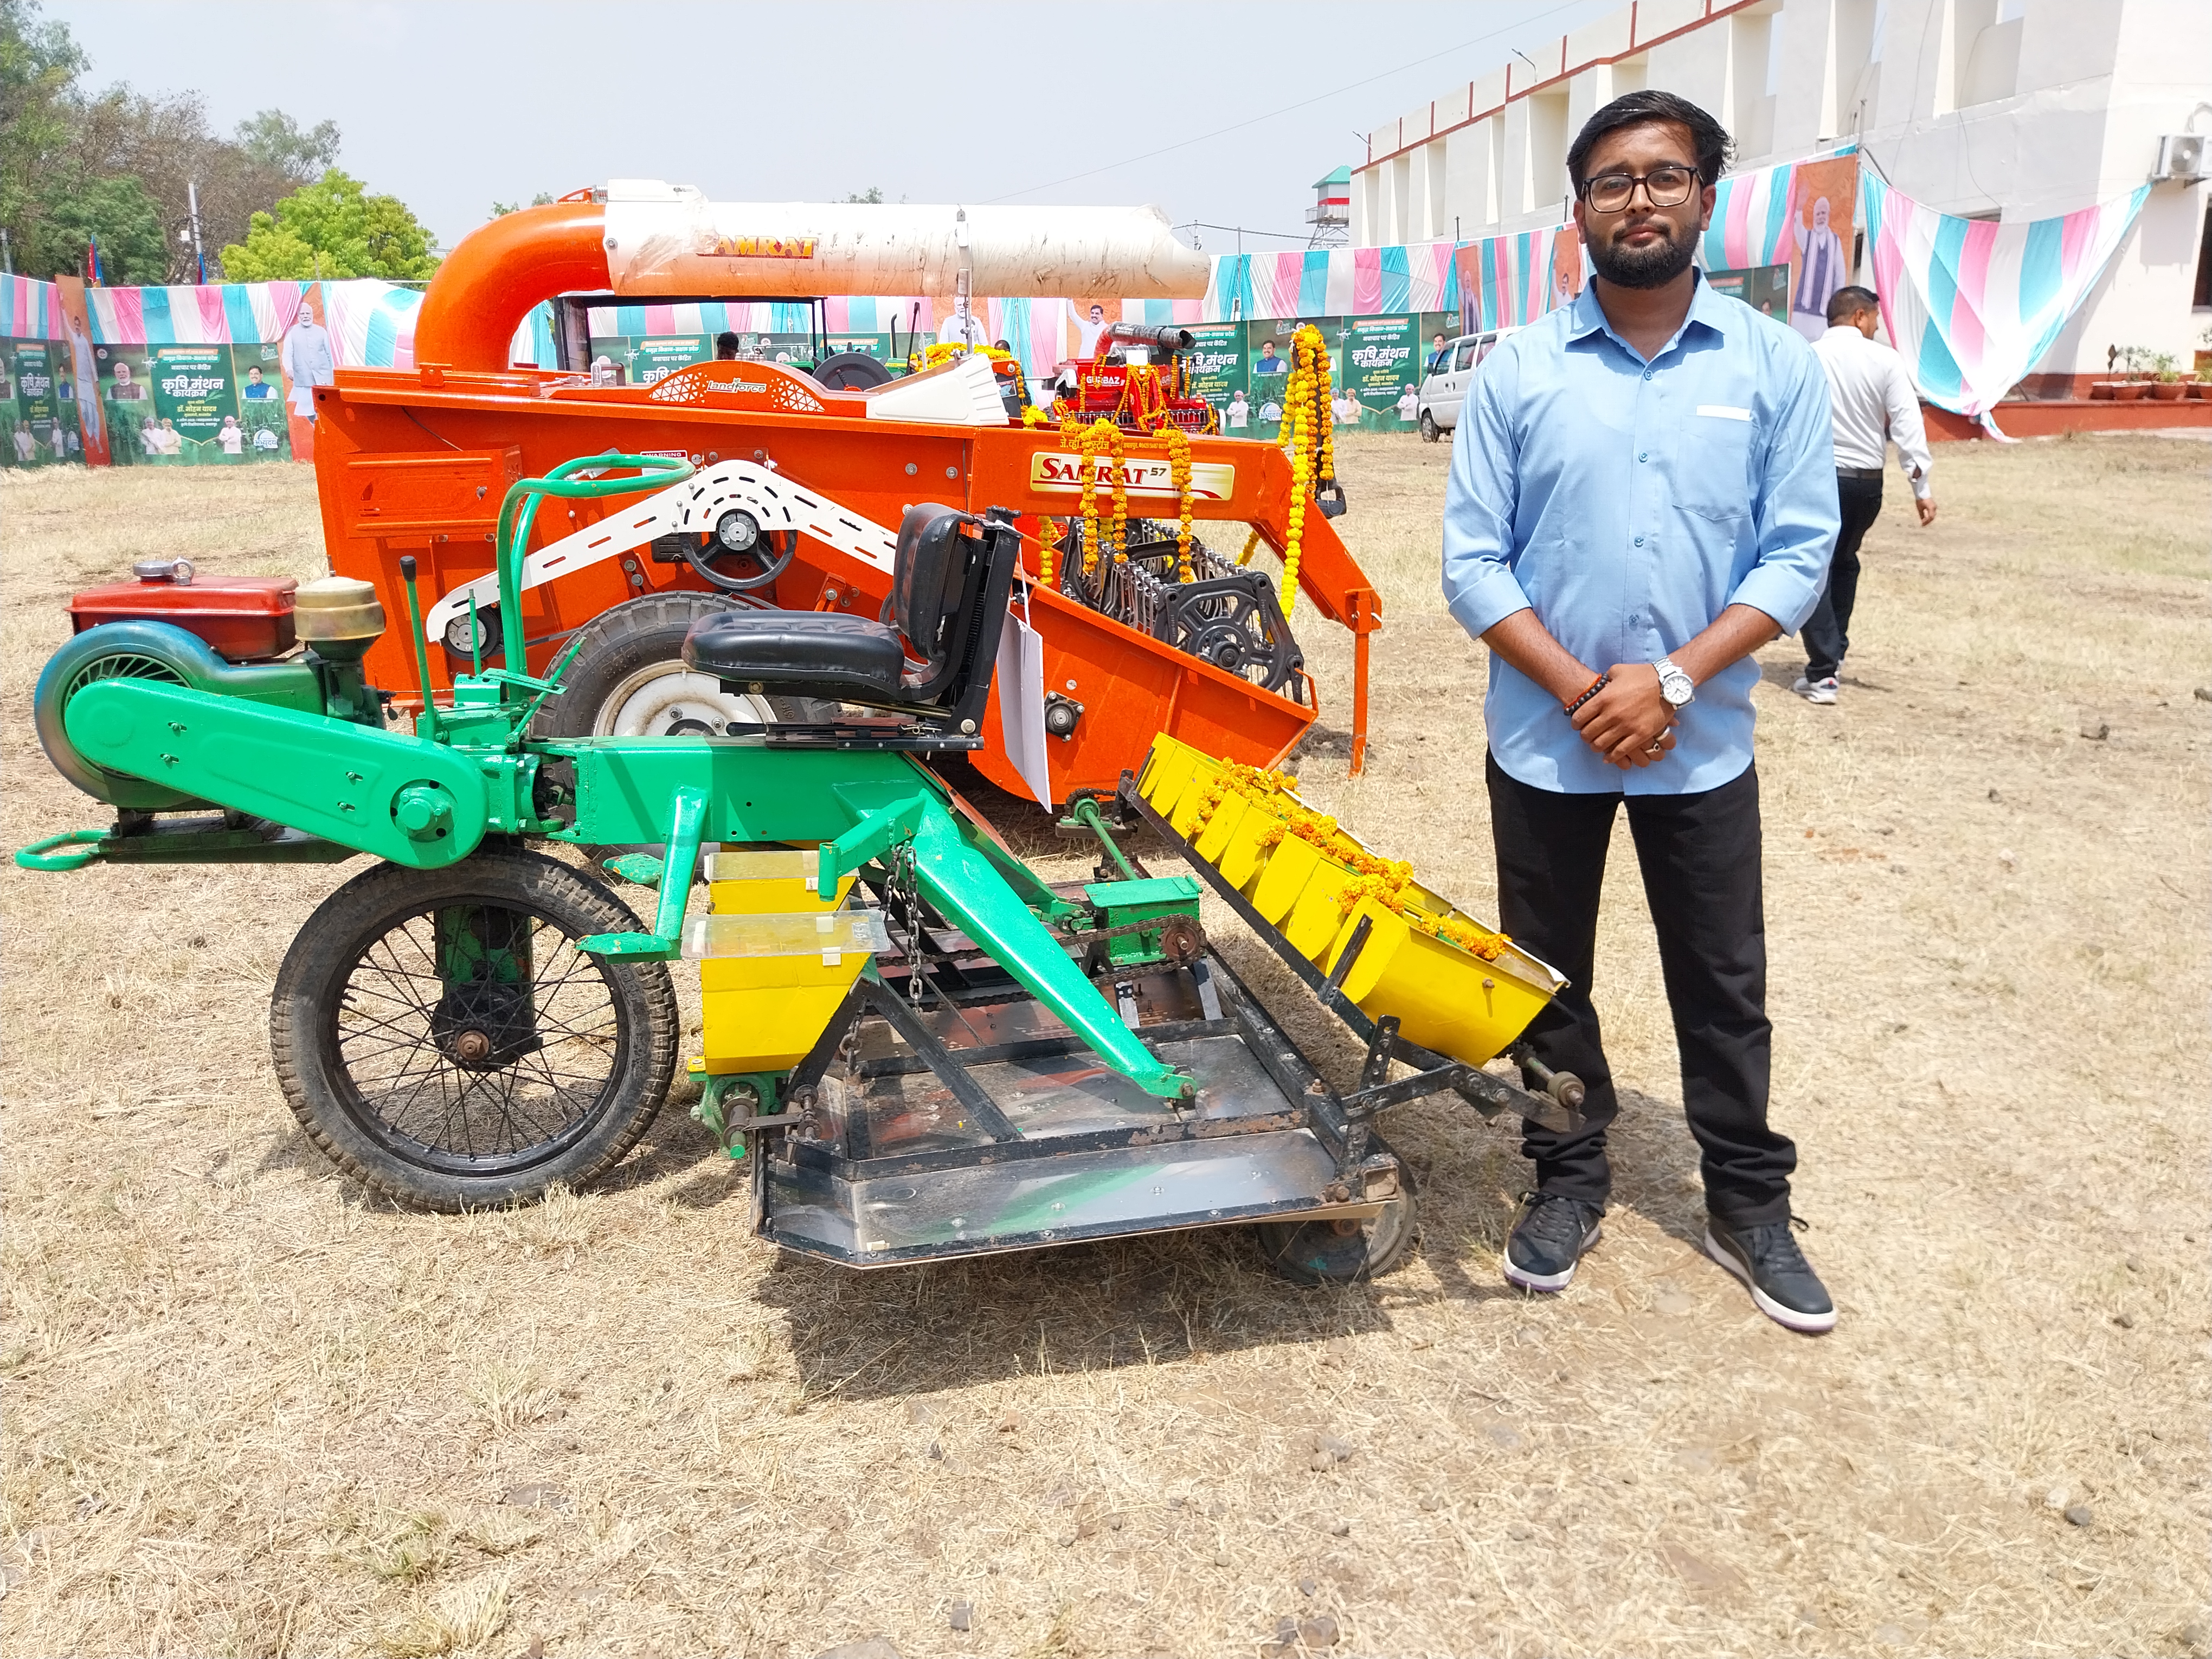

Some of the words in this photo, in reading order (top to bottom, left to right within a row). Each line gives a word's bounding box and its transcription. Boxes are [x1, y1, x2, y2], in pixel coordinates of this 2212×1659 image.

[713, 235, 818, 256] AMRAT
[1206, 351, 1238, 365] मंथन
[1352, 345, 1378, 365] कृषि
[1379, 345, 1411, 359] मंथन
[1360, 357, 1393, 368] कार्यक्रम
[162, 375, 189, 394] कृषि
[190, 375, 224, 390] मंथन
[708, 381, 766, 392] landforce
[172, 387, 208, 397] कार्यक्रम
[1150, 467, 1167, 477] 57
